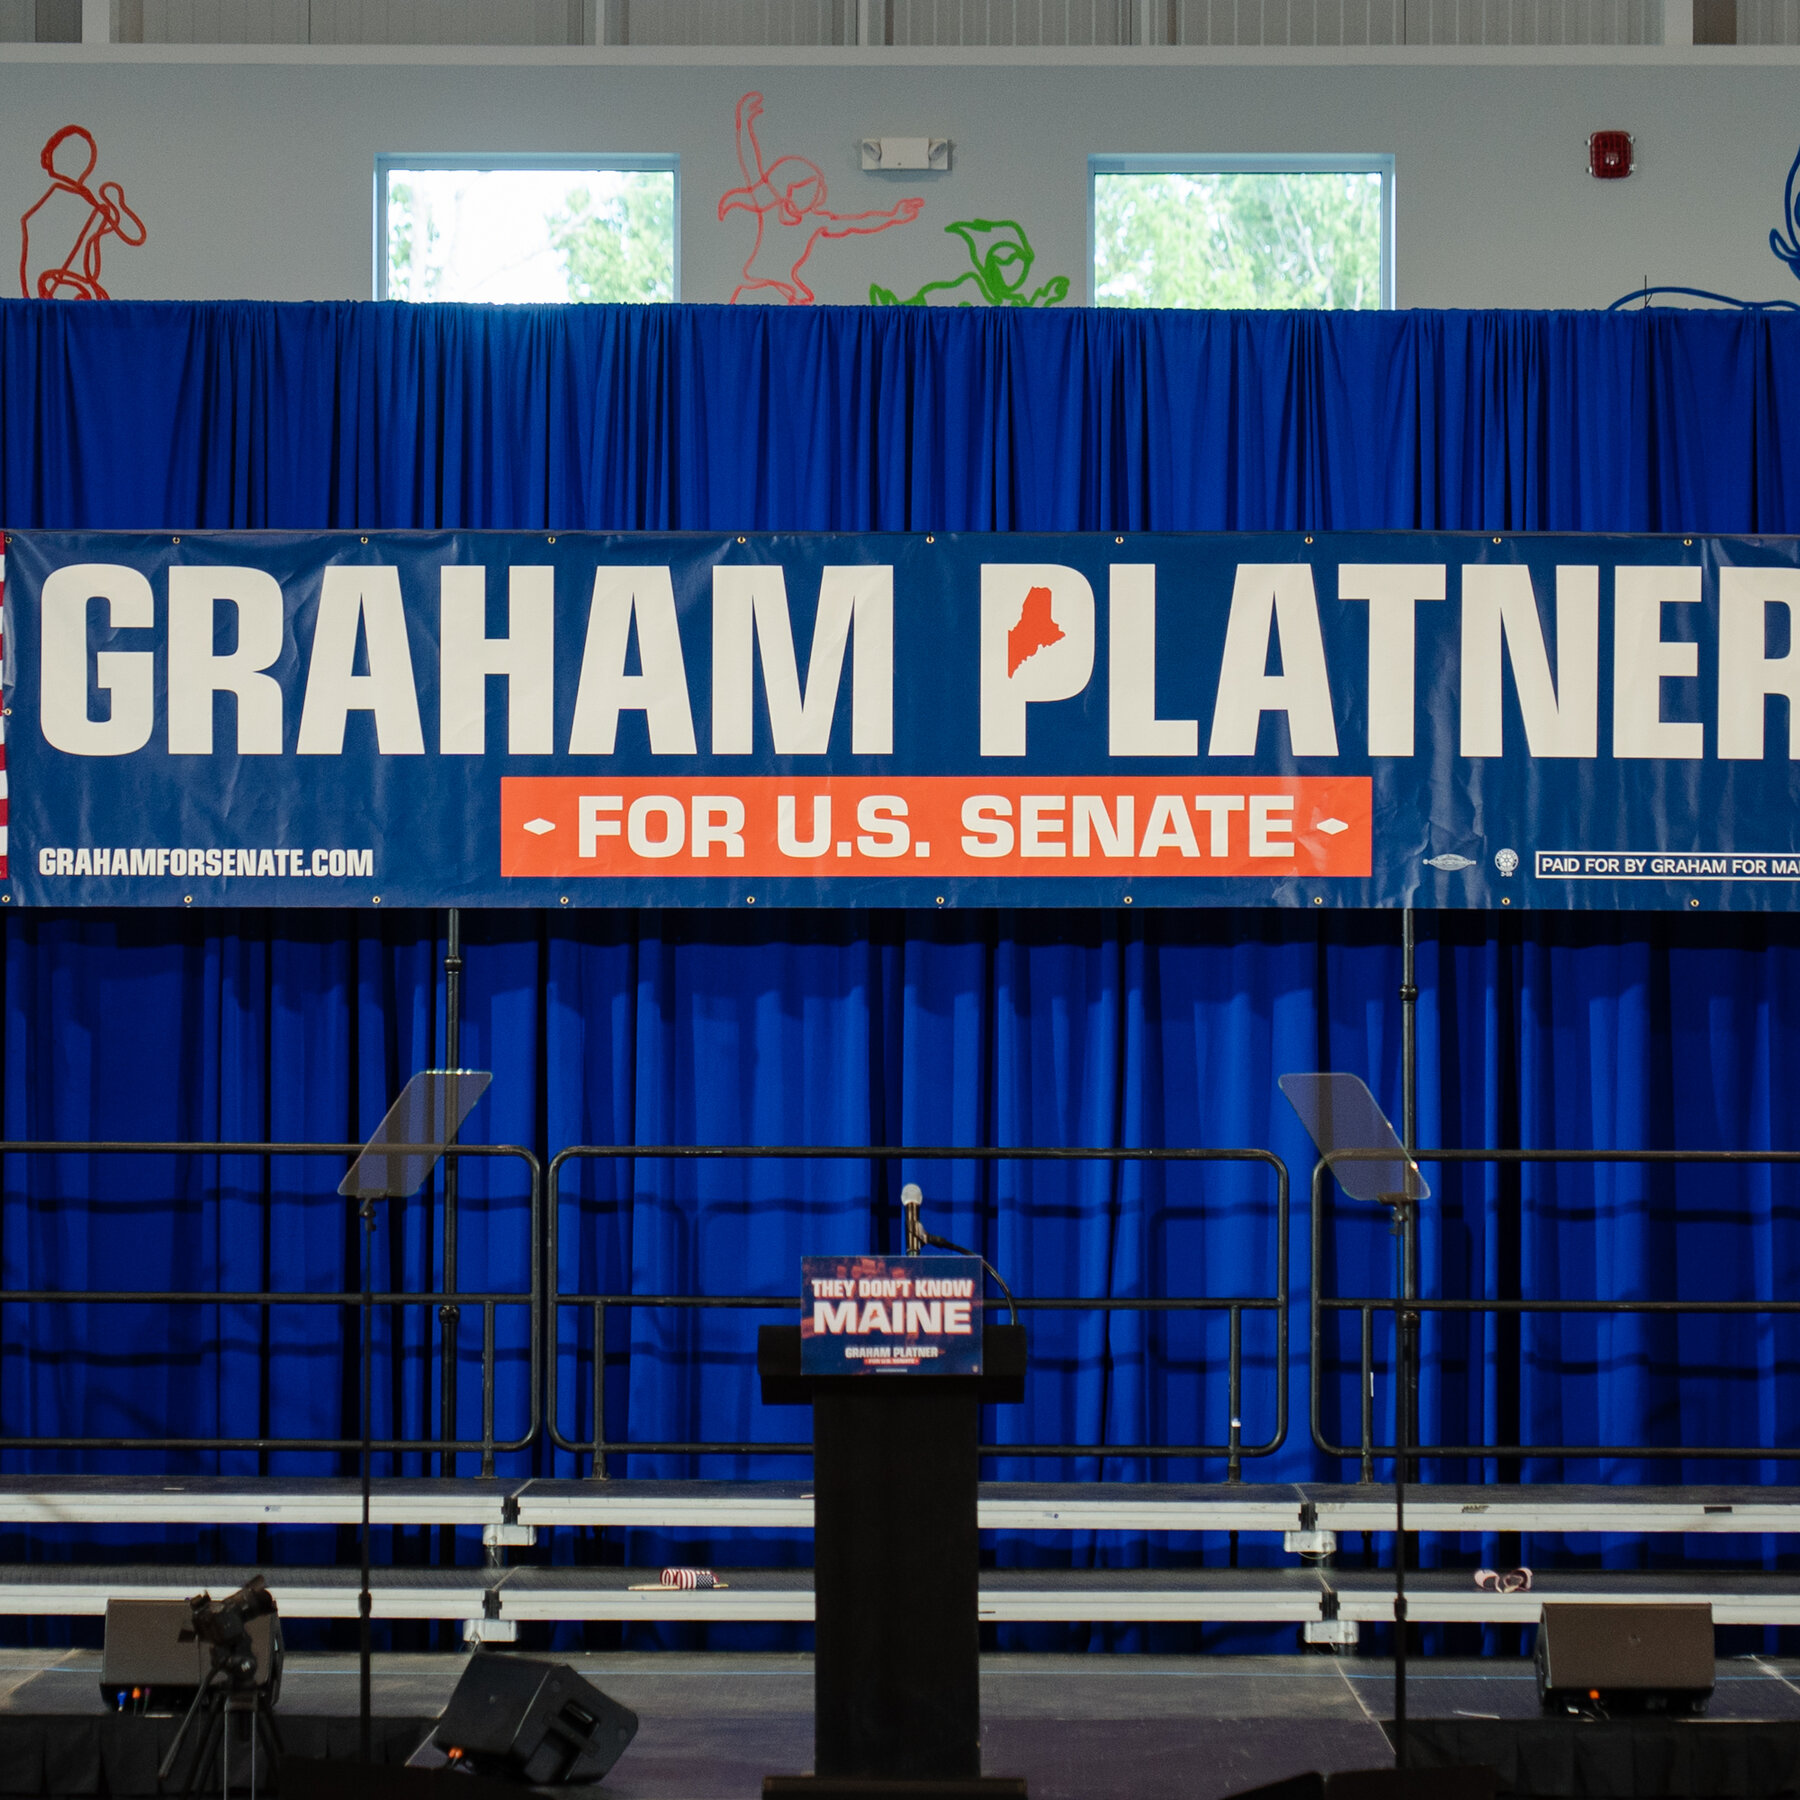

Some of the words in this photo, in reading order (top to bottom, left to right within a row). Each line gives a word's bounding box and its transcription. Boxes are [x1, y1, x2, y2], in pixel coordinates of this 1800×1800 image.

[40, 564, 893, 756] GRAHAM
[979, 563, 1800, 760] PLATNER
[578, 795, 746, 858] FOR
[777, 795, 930, 858] U.S.
[961, 795, 1295, 858] SENATE
[38, 848, 374, 877] GRAHAMFORSENATE.COM
[1542, 858, 1580, 873] PAID
[1585, 859, 1620, 873] FOR
[1624, 859, 1647, 873] BY
[1651, 859, 1727, 874] GRAHAM
[1732, 860, 1767, 874] FOR
[1772, 860, 1800, 874] MA
[812, 1279, 855, 1297] THEY
[858, 1279, 912, 1298] DON'T
[914, 1279, 973, 1298] KNOW
[813, 1301, 972, 1334] MAINE
[845, 1347, 891, 1358] GRAHAM
[893, 1347, 938, 1358] PLATNER
